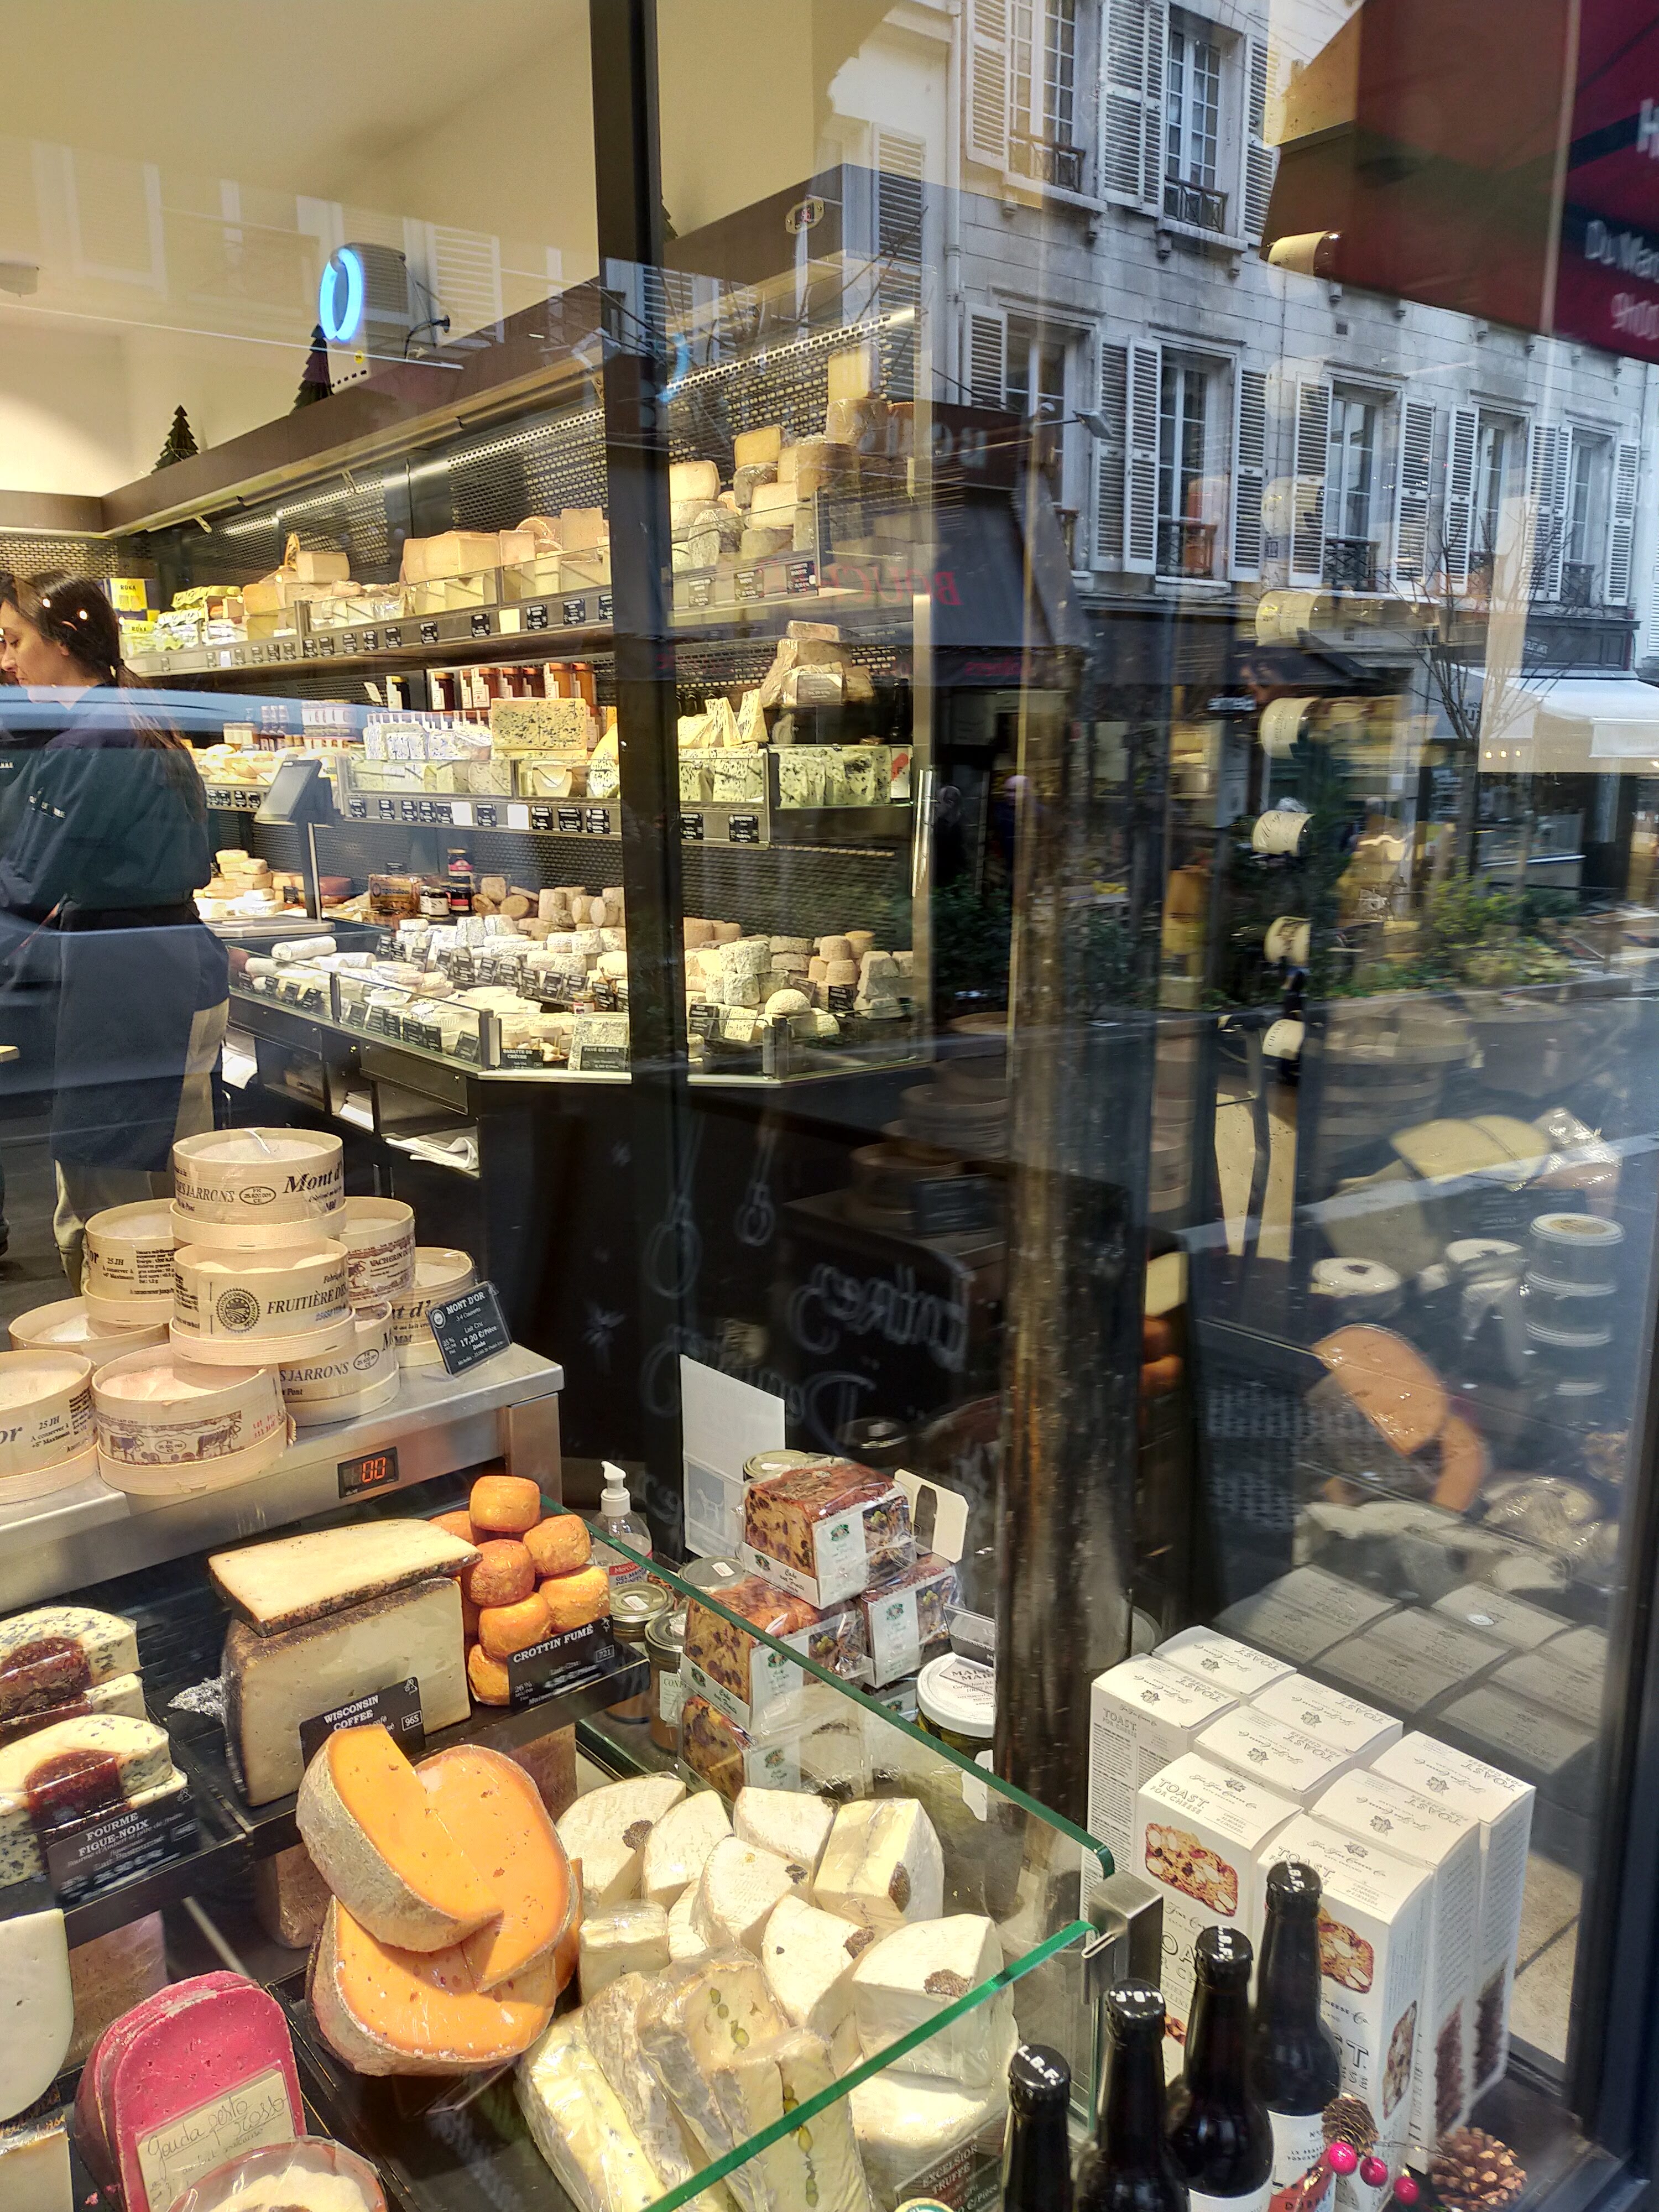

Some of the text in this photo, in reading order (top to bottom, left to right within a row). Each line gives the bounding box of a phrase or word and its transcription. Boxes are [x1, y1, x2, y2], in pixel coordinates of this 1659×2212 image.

[267, 1290, 333, 1314] FRUITIÈRE
[446, 1292, 486, 1314] MONT D'OR
[39, 1421, 48, 1430] 25
[513, 1623, 594, 1663] CROTTIN FUMÉ
[324, 1694, 379, 1724] WISCONSIN
[333, 1709, 373, 1731] COFFEE
[405, 1714, 419, 1727] 965
[1150, 1785, 1202, 1814] FOR CHEESE
[78, 1819, 150, 1857] FIGUE-NOIX
[86, 1812, 138, 1841] FOURME
[1017, 2045, 1060, 2086] L.B.F.
